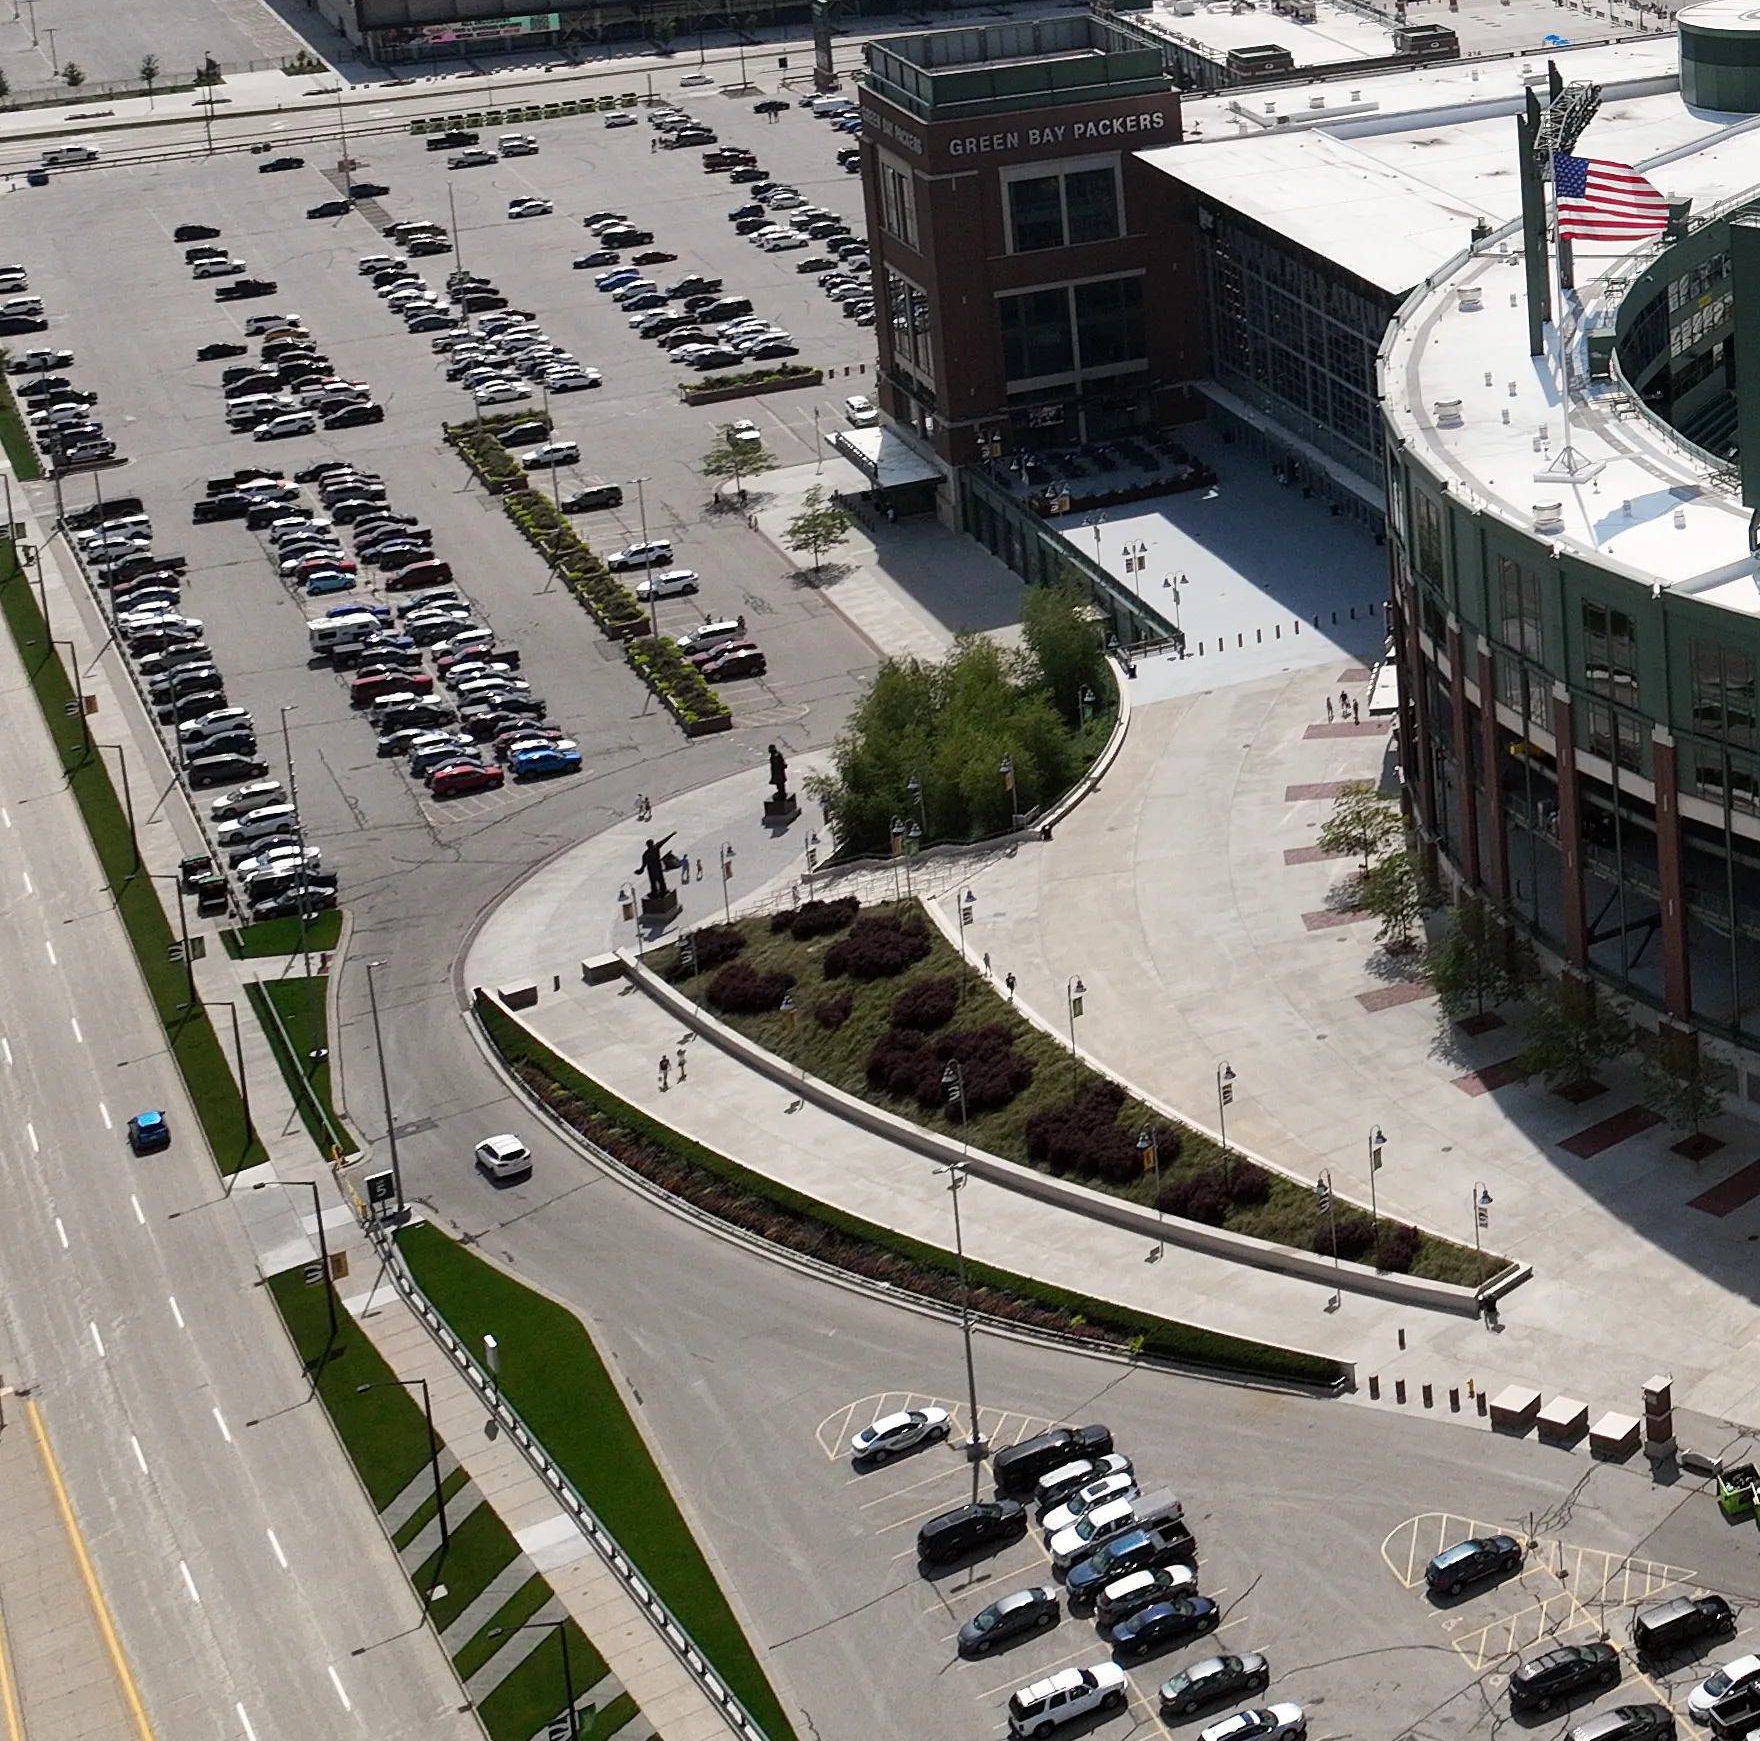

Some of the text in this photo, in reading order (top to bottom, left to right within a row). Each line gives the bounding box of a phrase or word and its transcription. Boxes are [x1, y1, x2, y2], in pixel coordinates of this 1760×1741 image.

[949, 111, 1165, 156] GREEN BAY PACKERS
[376, 1183, 386, 1196] 5
